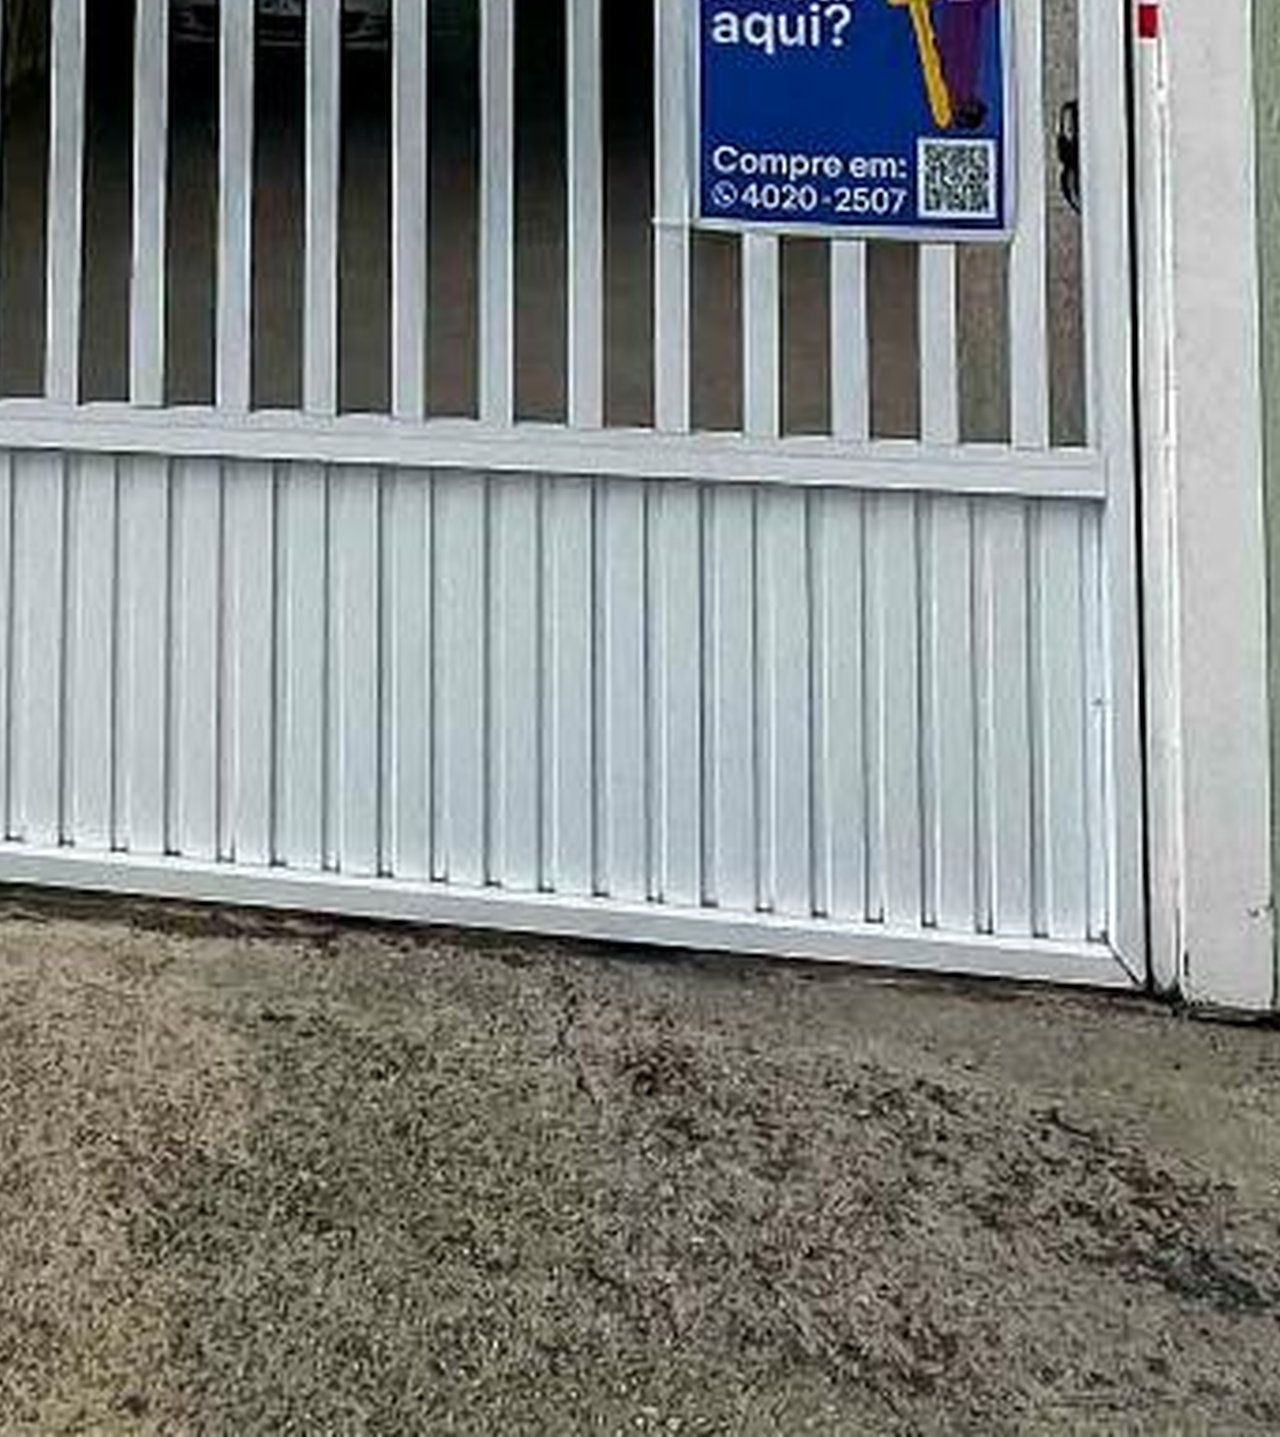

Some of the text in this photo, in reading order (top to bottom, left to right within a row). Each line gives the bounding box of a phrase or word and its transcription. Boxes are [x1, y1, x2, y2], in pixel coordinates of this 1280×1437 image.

[713, 3, 851, 55] aqui?
[713, 145, 908, 181] Compre em:
